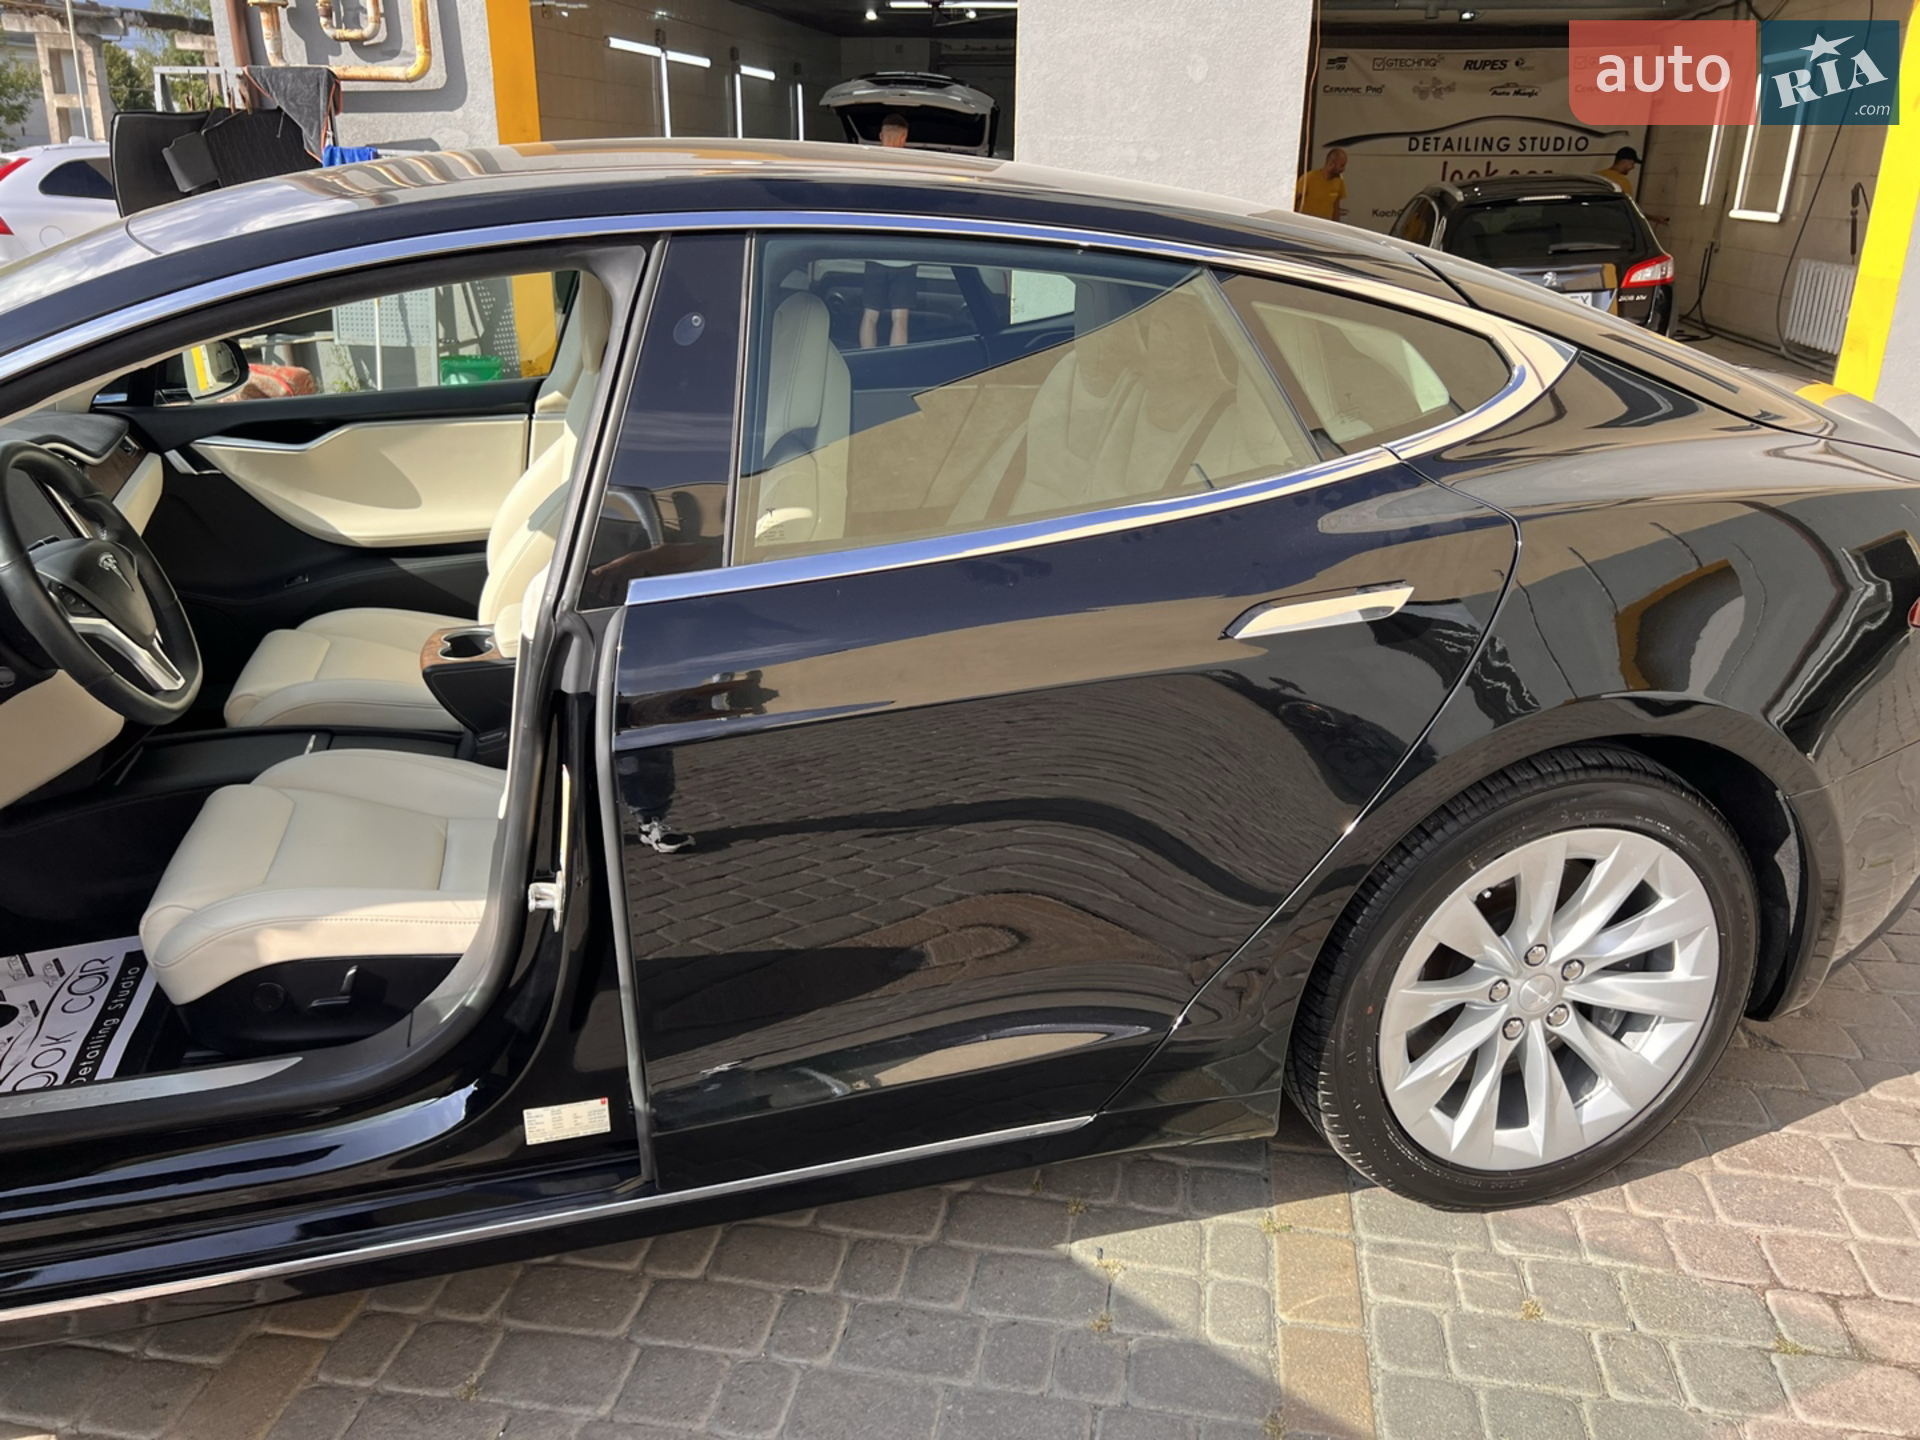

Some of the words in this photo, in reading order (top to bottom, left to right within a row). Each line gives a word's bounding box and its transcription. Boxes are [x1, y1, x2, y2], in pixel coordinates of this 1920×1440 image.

[1463, 59, 1508, 71] RUPES
[1408, 136, 1511, 152] DETAILING
[1518, 136, 1589, 152] STUDIO
